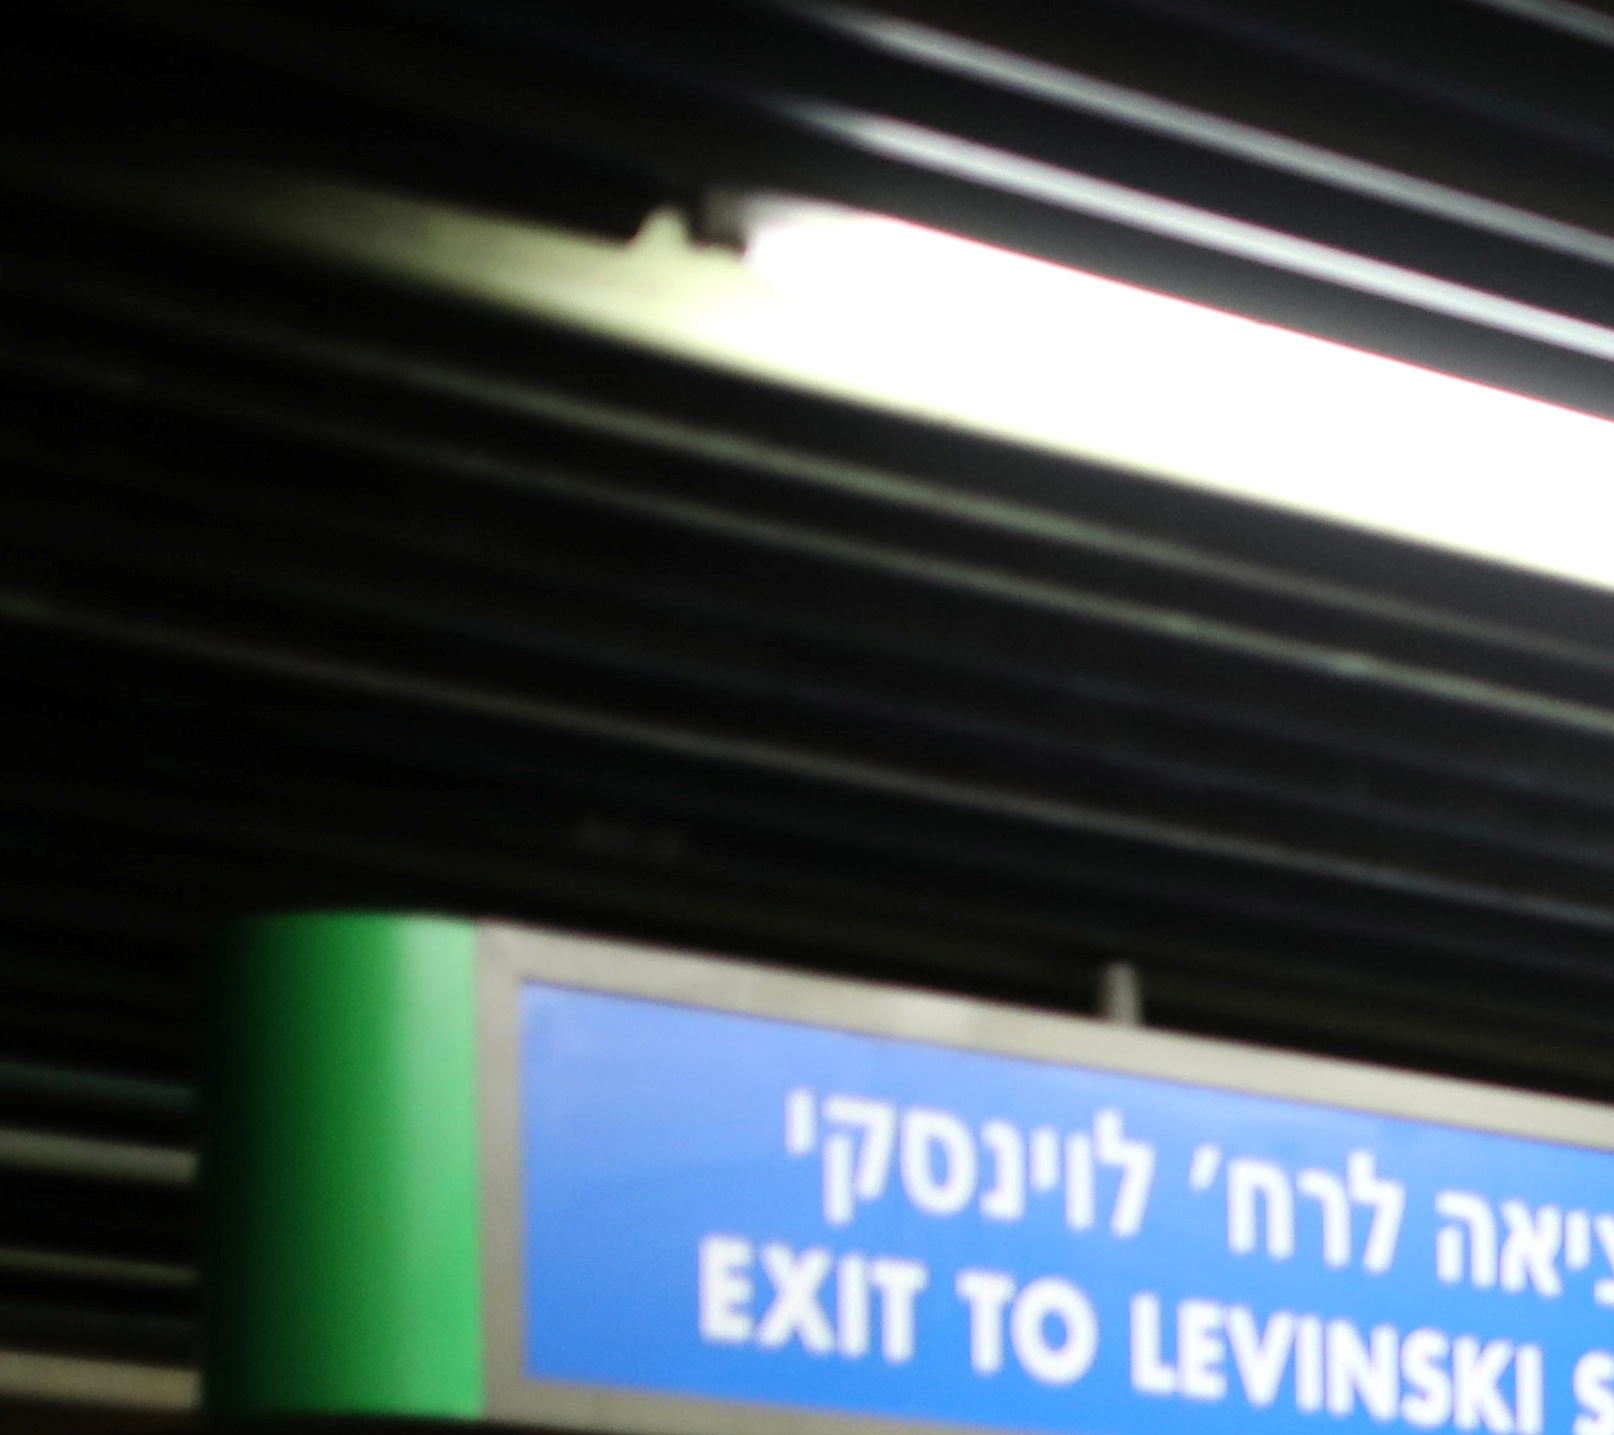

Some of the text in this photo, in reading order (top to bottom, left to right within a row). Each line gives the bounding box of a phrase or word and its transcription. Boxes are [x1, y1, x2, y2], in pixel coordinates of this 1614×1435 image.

[783, 1088, 1153, 1238] לוינסקי
[699, 1234, 927, 1363] EXIT
[956, 1268, 1098, 1386] TO
